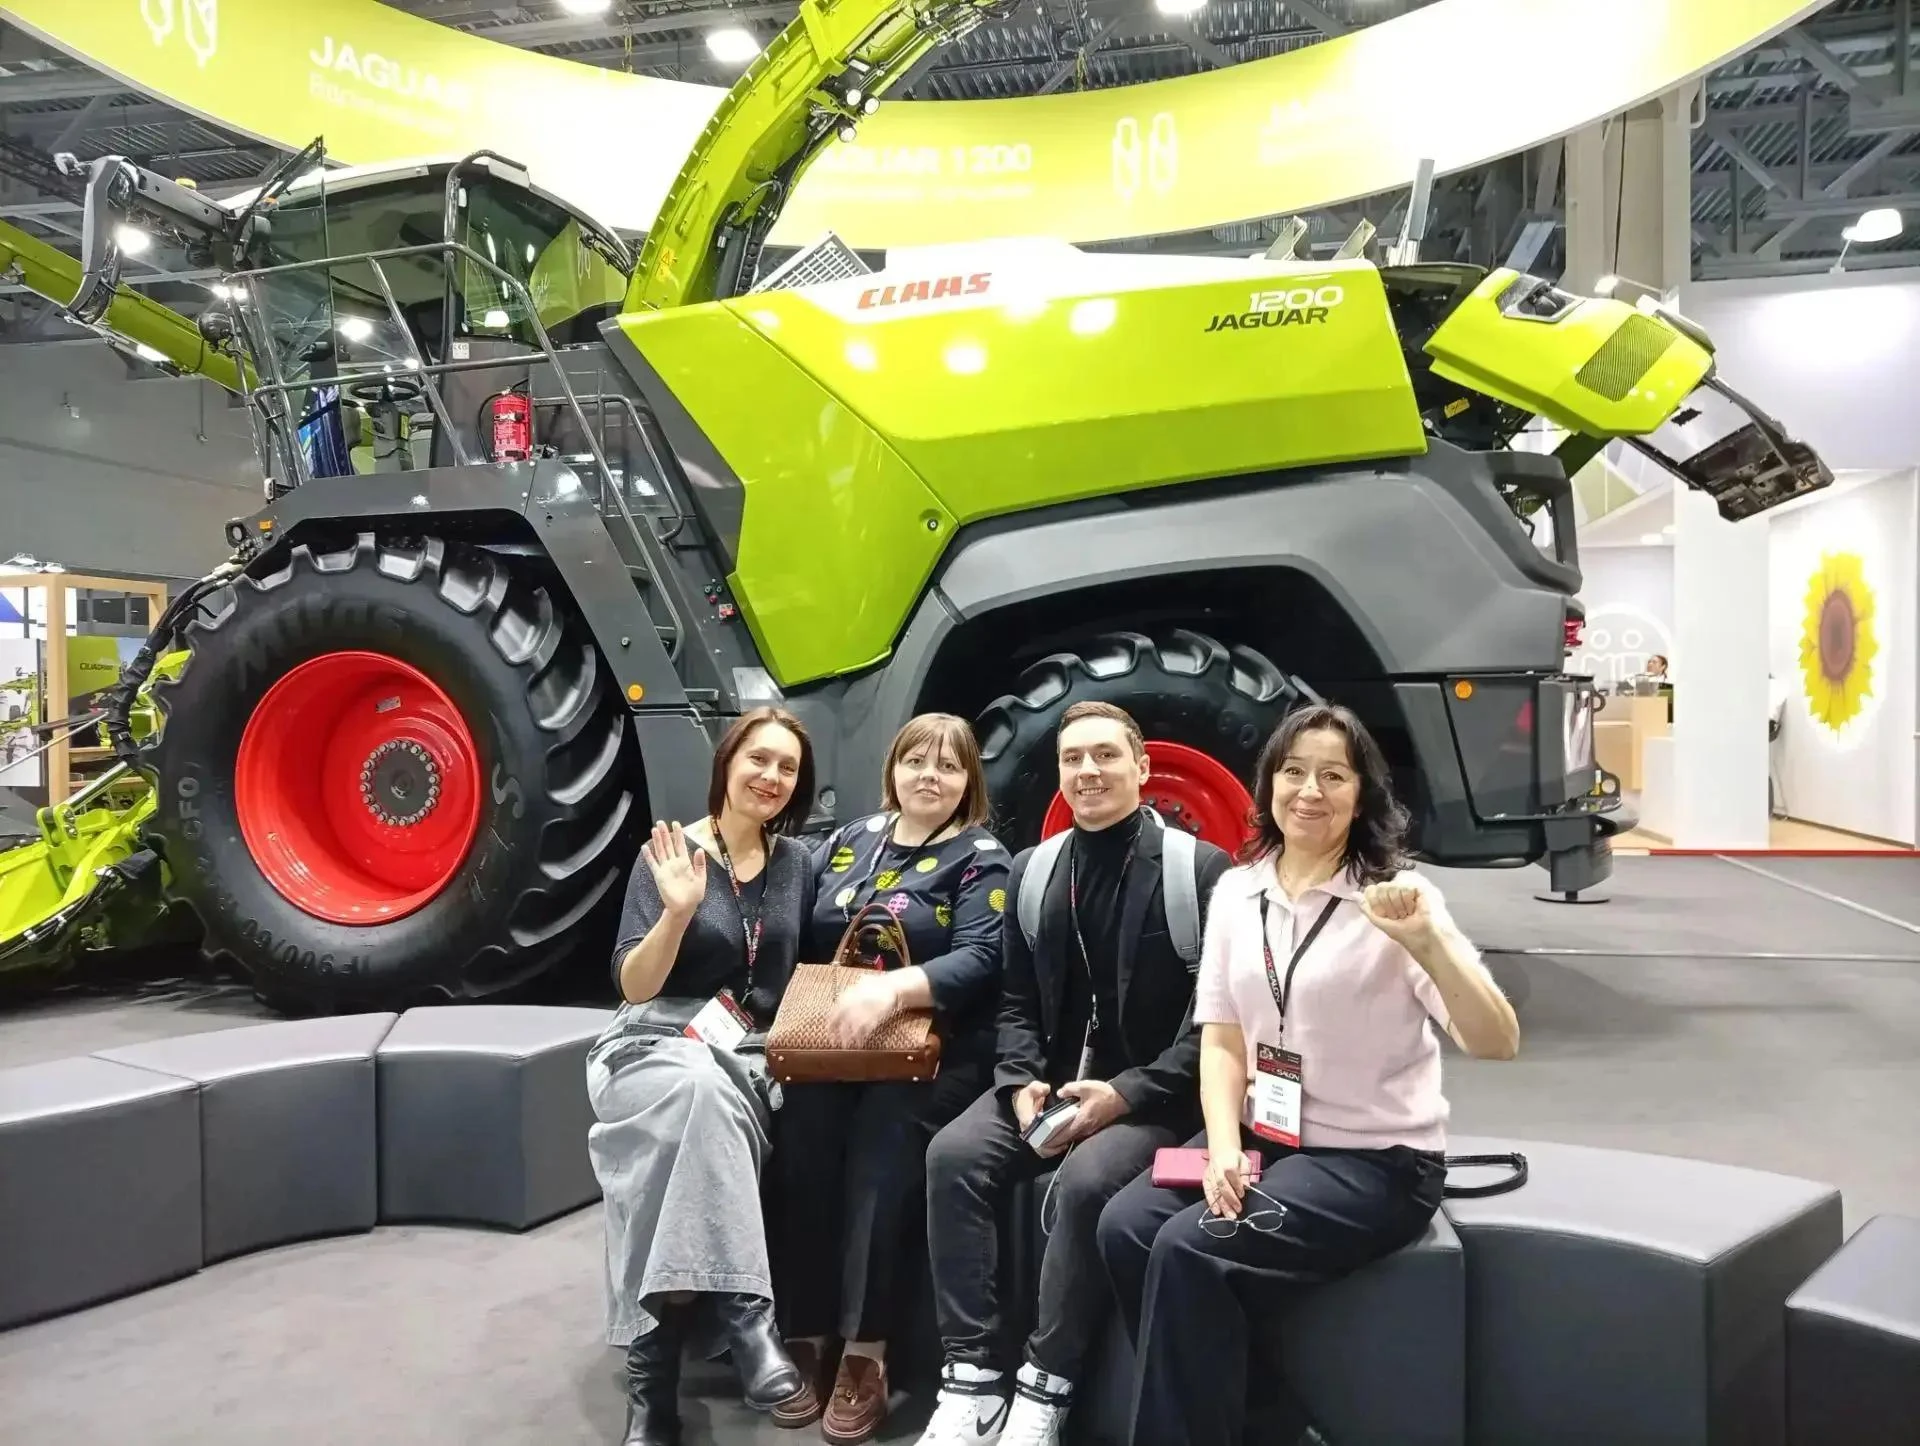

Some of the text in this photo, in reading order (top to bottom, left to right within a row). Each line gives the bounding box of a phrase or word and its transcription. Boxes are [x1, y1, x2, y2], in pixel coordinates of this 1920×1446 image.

[951, 142, 1034, 175] 1200
[857, 272, 993, 310] CLAAS
[1248, 285, 1345, 313] 1200
[1204, 306, 1329, 333] JAGUAR
